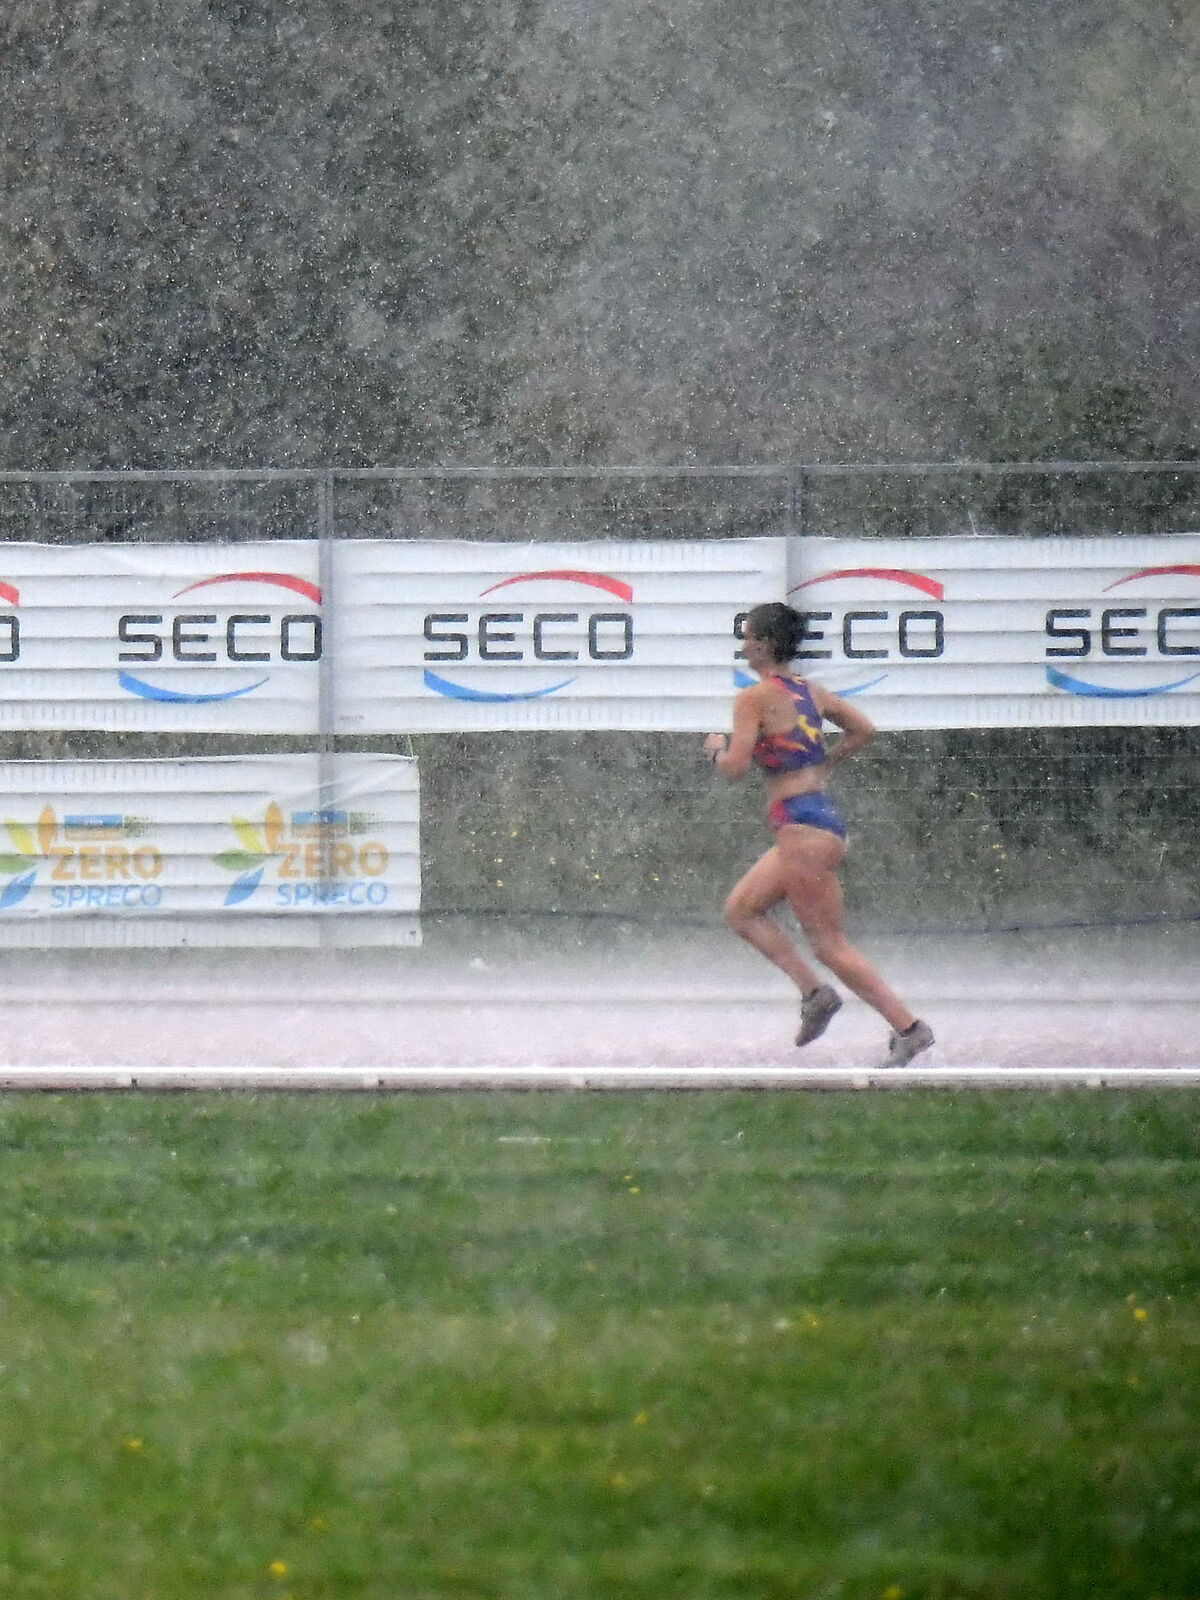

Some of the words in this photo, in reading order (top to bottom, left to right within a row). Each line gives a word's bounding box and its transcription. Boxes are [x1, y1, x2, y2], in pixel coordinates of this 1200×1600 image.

[118, 614, 323, 662] SECO
[423, 613, 634, 661] SECO
[48, 845, 164, 880] ZERO
[275, 841, 389, 877] ZERO
[50, 883, 162, 908] SPRECO
[276, 880, 388, 906] SPRECO
